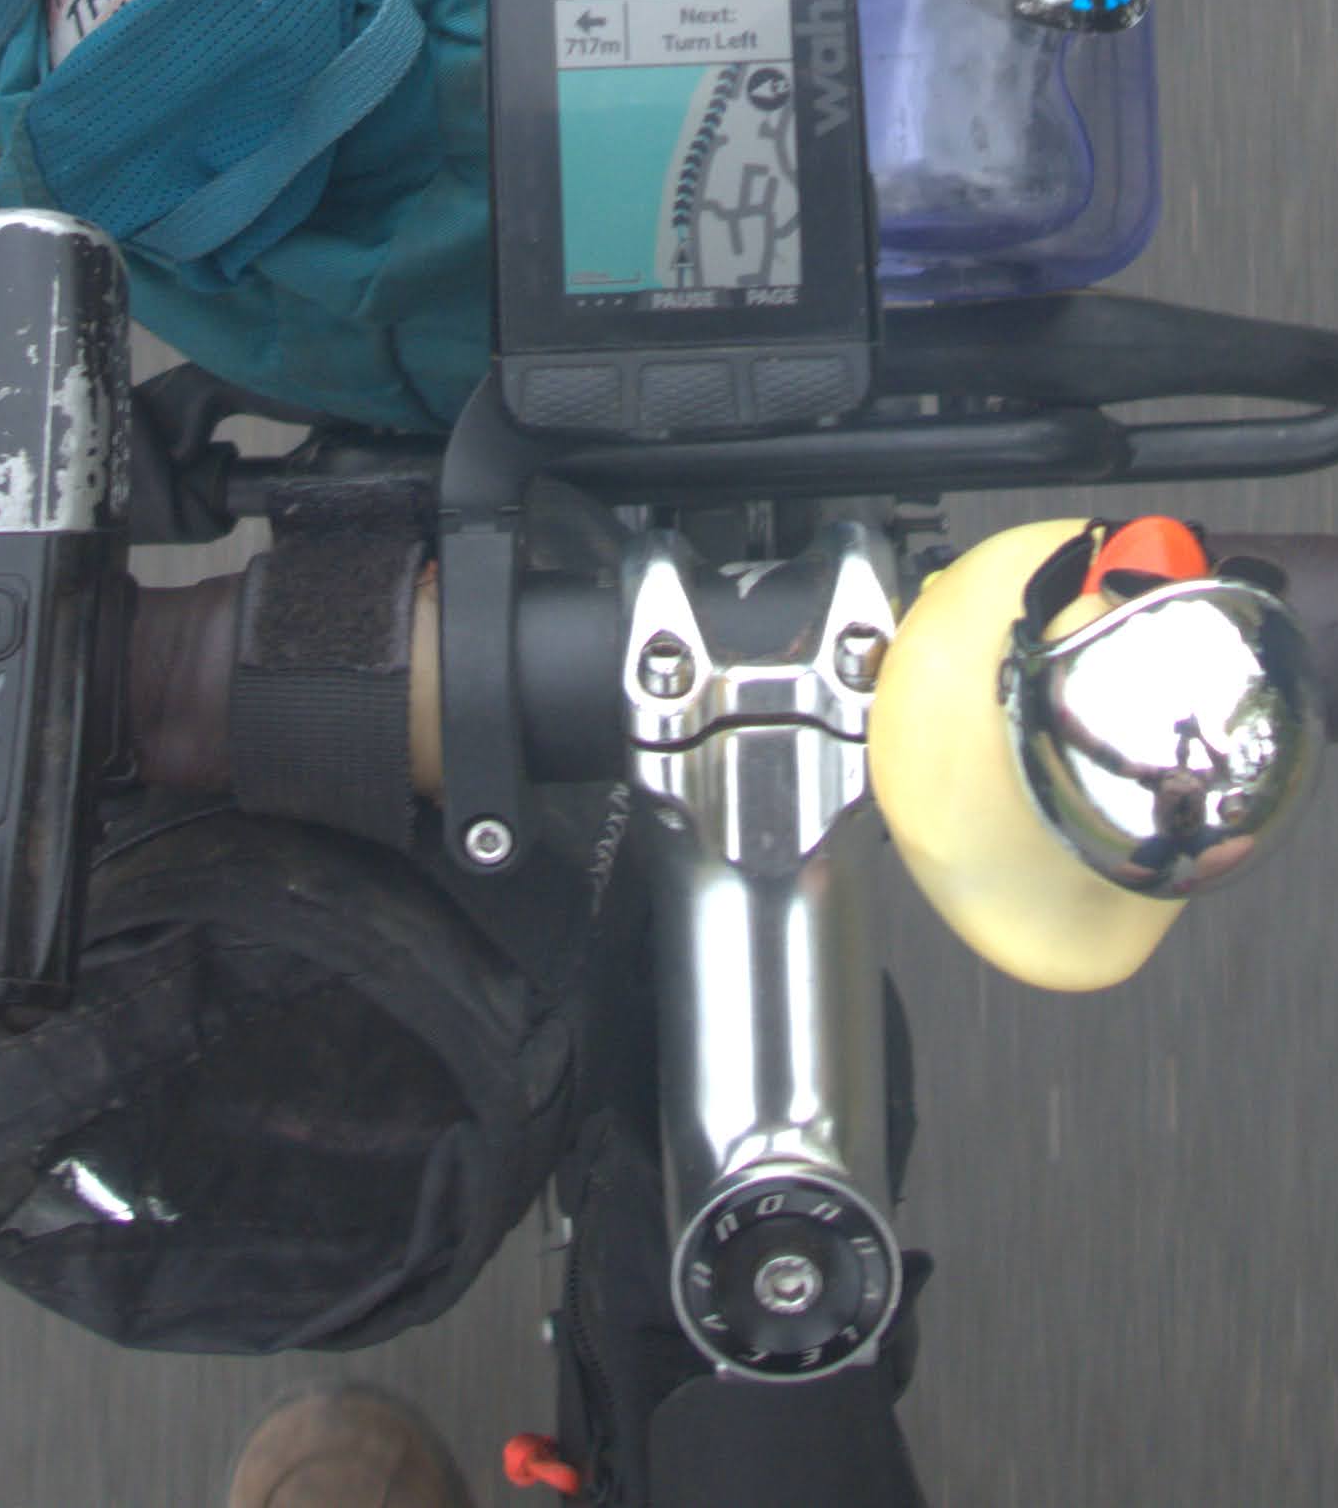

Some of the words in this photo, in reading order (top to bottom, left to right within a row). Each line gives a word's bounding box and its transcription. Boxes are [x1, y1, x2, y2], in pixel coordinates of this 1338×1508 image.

[564, 37, 621, 57] 717m
[662, 33, 712, 52] Turn
[715, 30, 758, 50] Left
